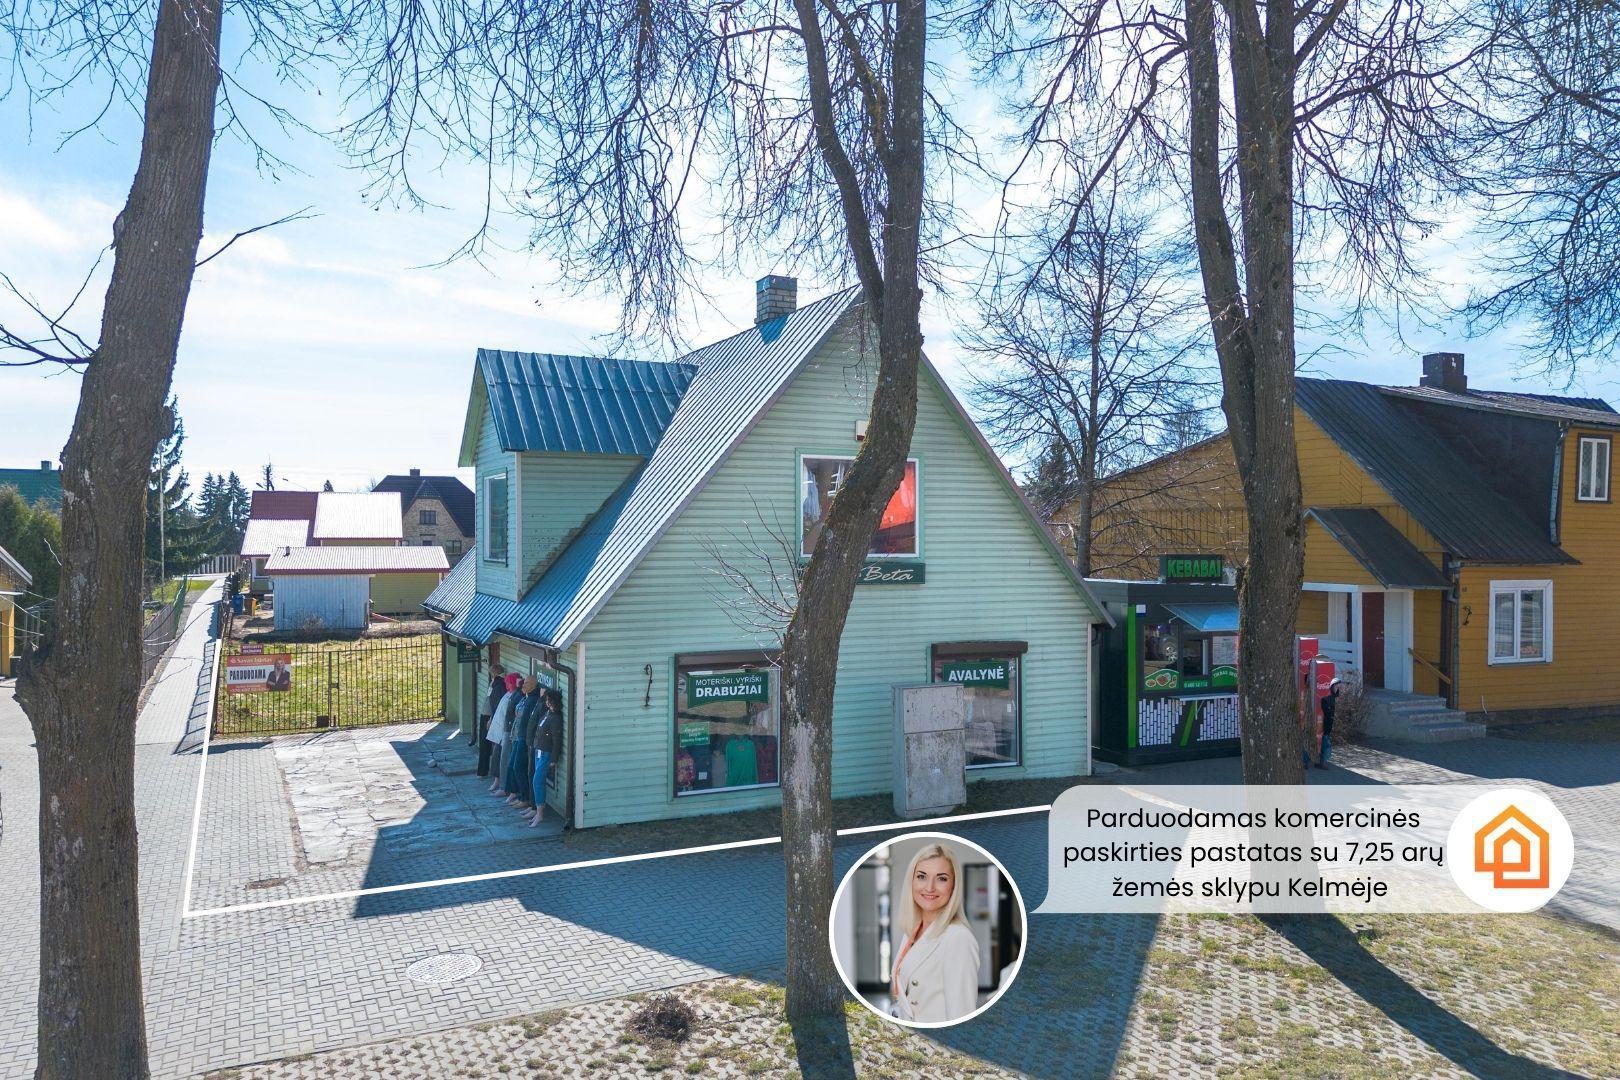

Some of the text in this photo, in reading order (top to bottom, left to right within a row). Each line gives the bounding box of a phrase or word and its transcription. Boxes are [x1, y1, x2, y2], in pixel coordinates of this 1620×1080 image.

[862, 566, 914, 581] Beta
[1167, 559, 1221, 578] KEBABAI
[229, 669, 266, 680] PARDUODAMA
[736, 675, 762, 684] VYRIŠKI
[948, 666, 1004, 682] AVALYNĖ
[695, 684, 762, 698] DRABUŽIAI
